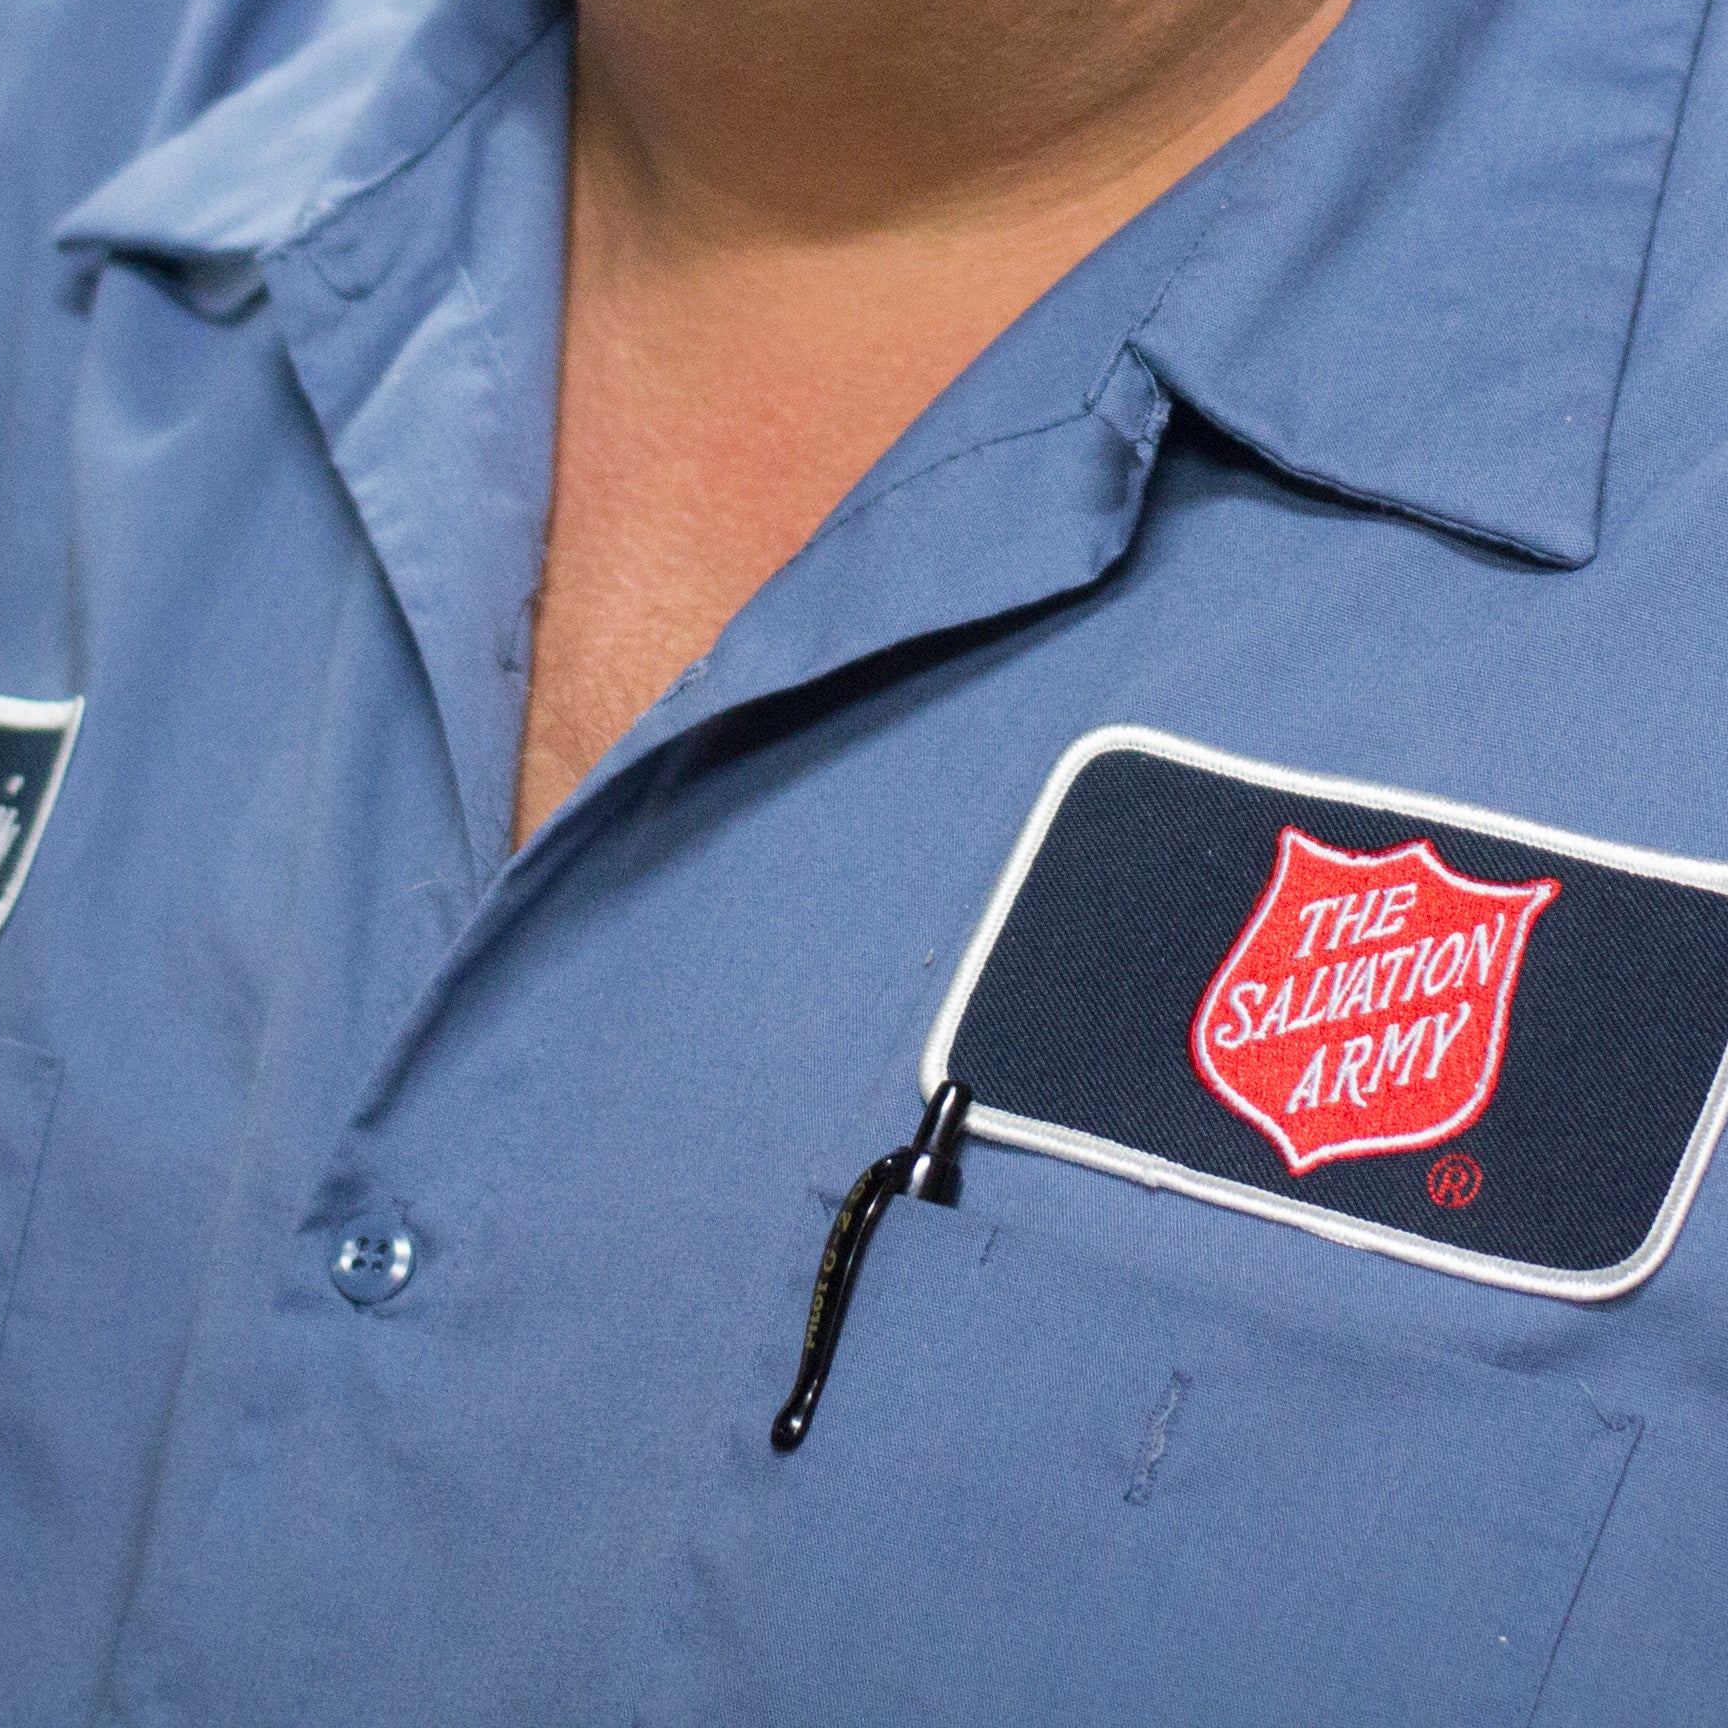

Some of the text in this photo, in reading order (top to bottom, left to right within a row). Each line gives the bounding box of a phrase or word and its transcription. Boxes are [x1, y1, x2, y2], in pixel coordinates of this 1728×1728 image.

[1292, 882, 1417, 960] THE
[1213, 912, 1505, 1049] SALVATION
[1283, 1001, 1471, 1114] ARMY
